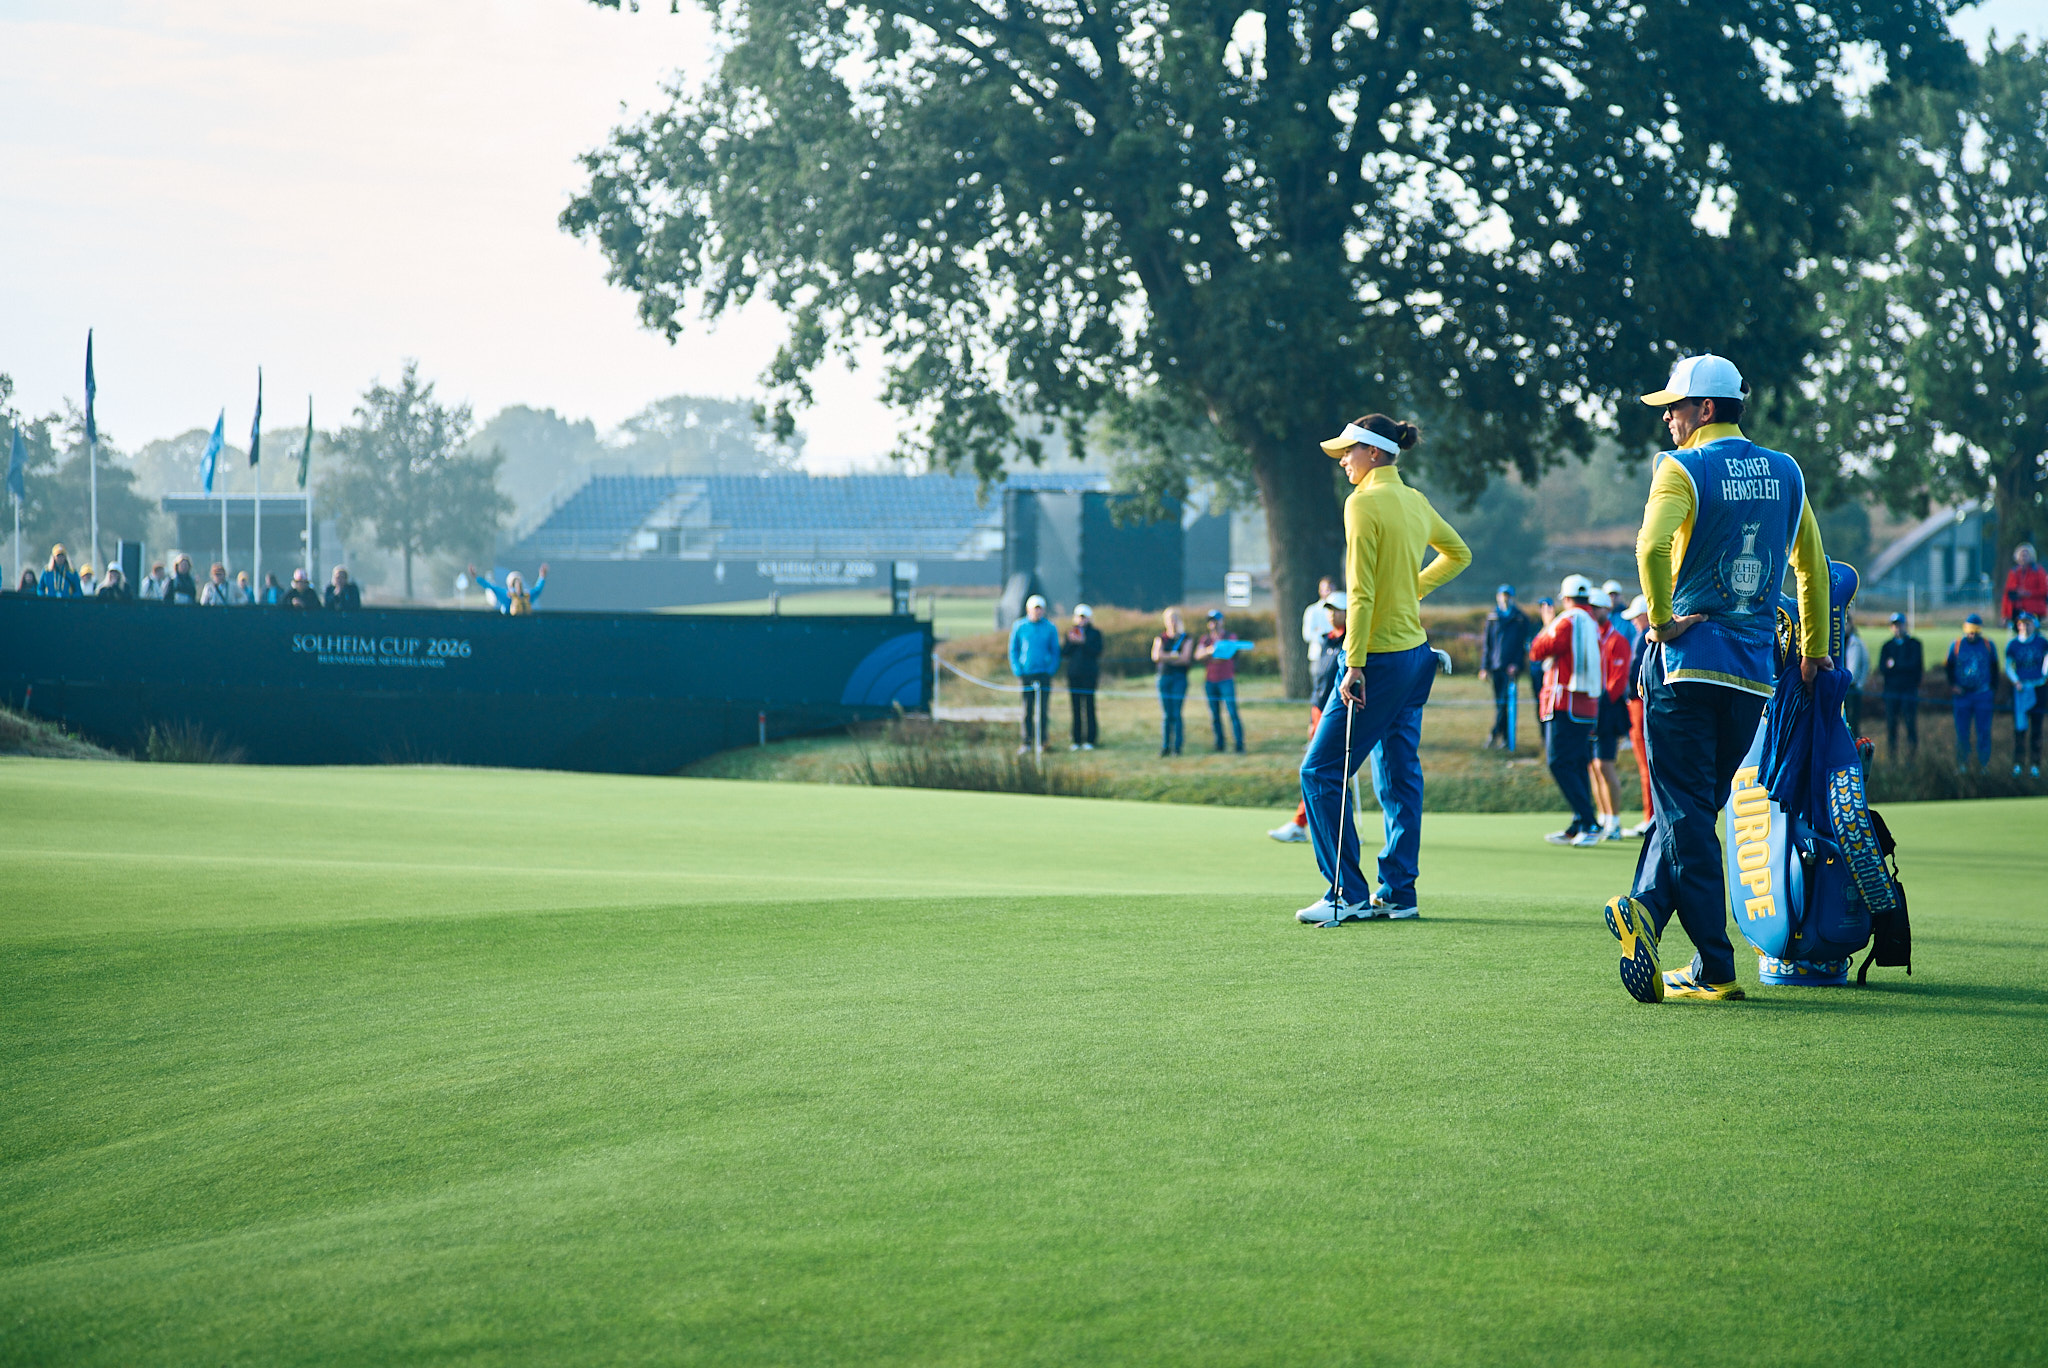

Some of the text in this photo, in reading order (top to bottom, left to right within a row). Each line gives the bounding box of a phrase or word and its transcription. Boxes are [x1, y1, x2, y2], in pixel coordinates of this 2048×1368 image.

[1725, 457, 1771, 477] ESTHER
[1721, 479, 1780, 500] HENSELEIT
[1735, 573, 1756, 583] CUP
[292, 633, 472, 658] SOLHEIM CUP 2026
[1731, 765, 1776, 921] EUROPE
[1848, 846, 1891, 911] EUROPE
